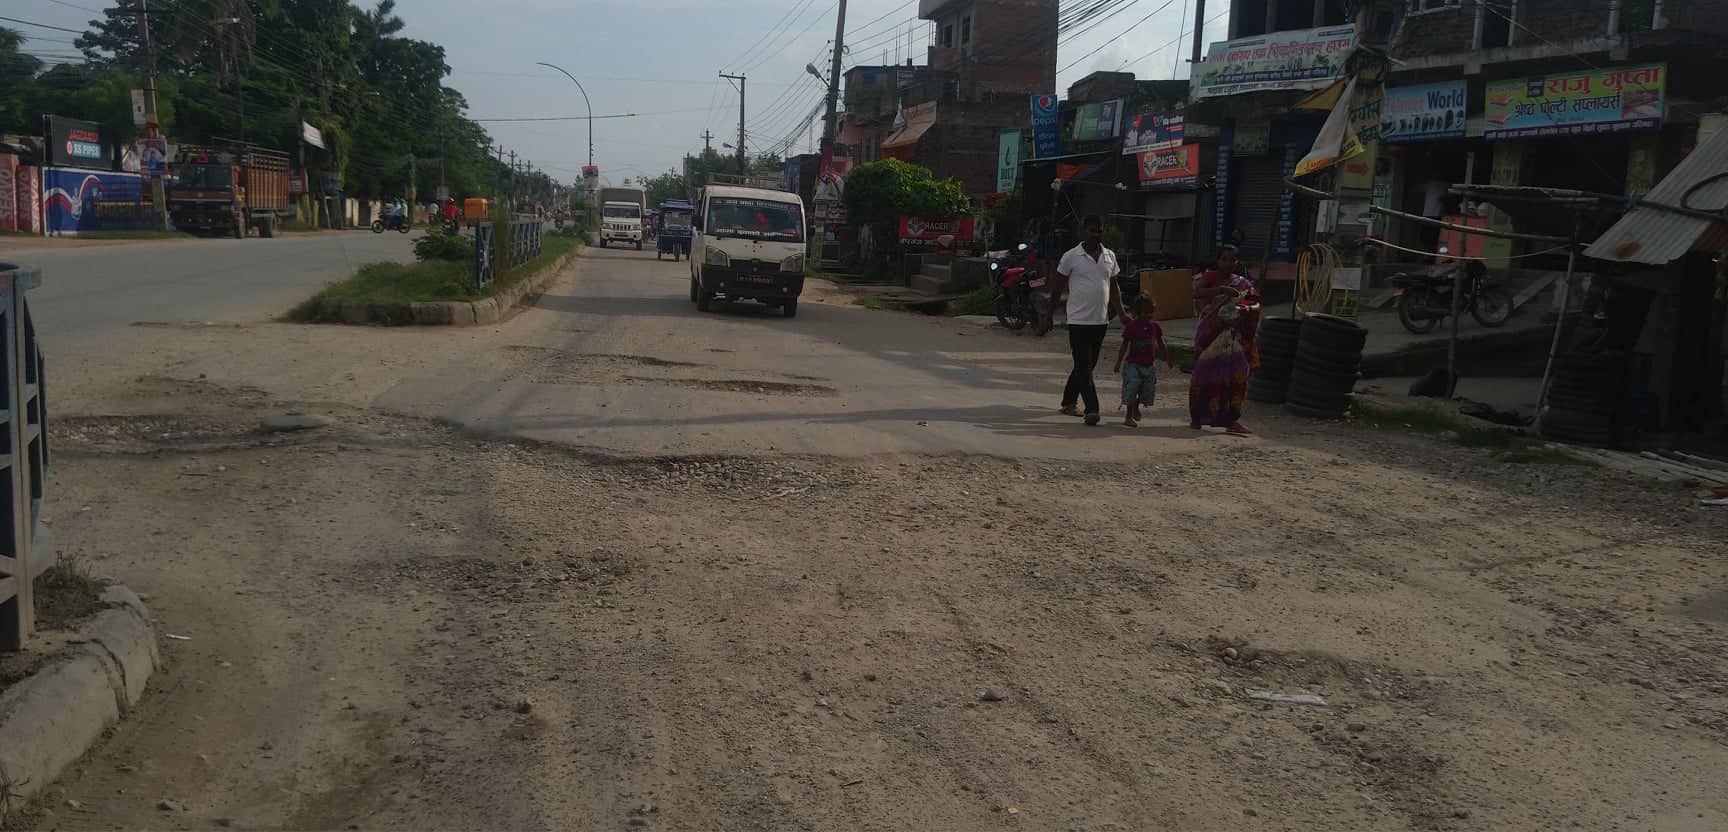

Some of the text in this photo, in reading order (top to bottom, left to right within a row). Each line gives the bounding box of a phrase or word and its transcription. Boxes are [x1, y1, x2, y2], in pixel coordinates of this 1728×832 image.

[1548, 76, 1592, 95] राजु
[1603, 68, 1661, 91] गुप्ता
[1427, 88, 1464, 110] World
[1157, 153, 1177, 167] RACER
[0, 168, 13, 219] SERVO
[924, 222, 947, 232] RACER
